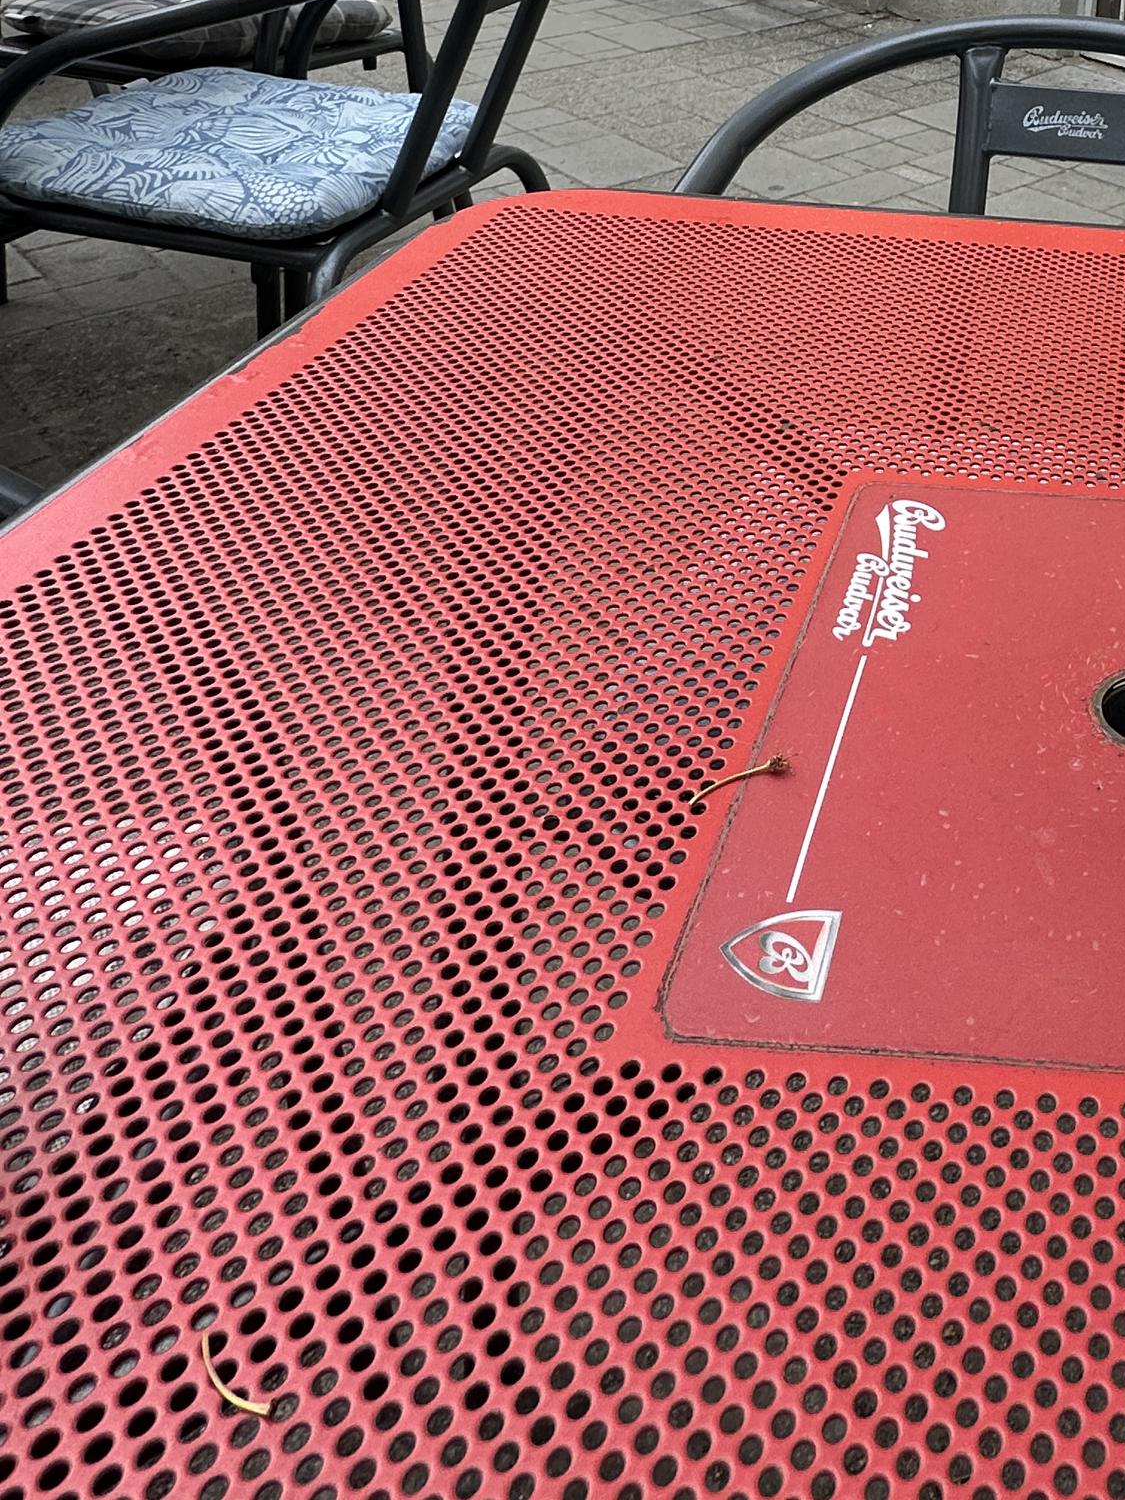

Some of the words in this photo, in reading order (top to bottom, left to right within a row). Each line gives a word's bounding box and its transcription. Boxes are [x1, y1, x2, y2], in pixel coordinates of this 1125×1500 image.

[1022, 105, 1107, 127] Budweiser
[1057, 124, 1104, 139] Budvar
[832, 553, 890, 641] Budvar
[876, 500, 946, 641] Budweiser
